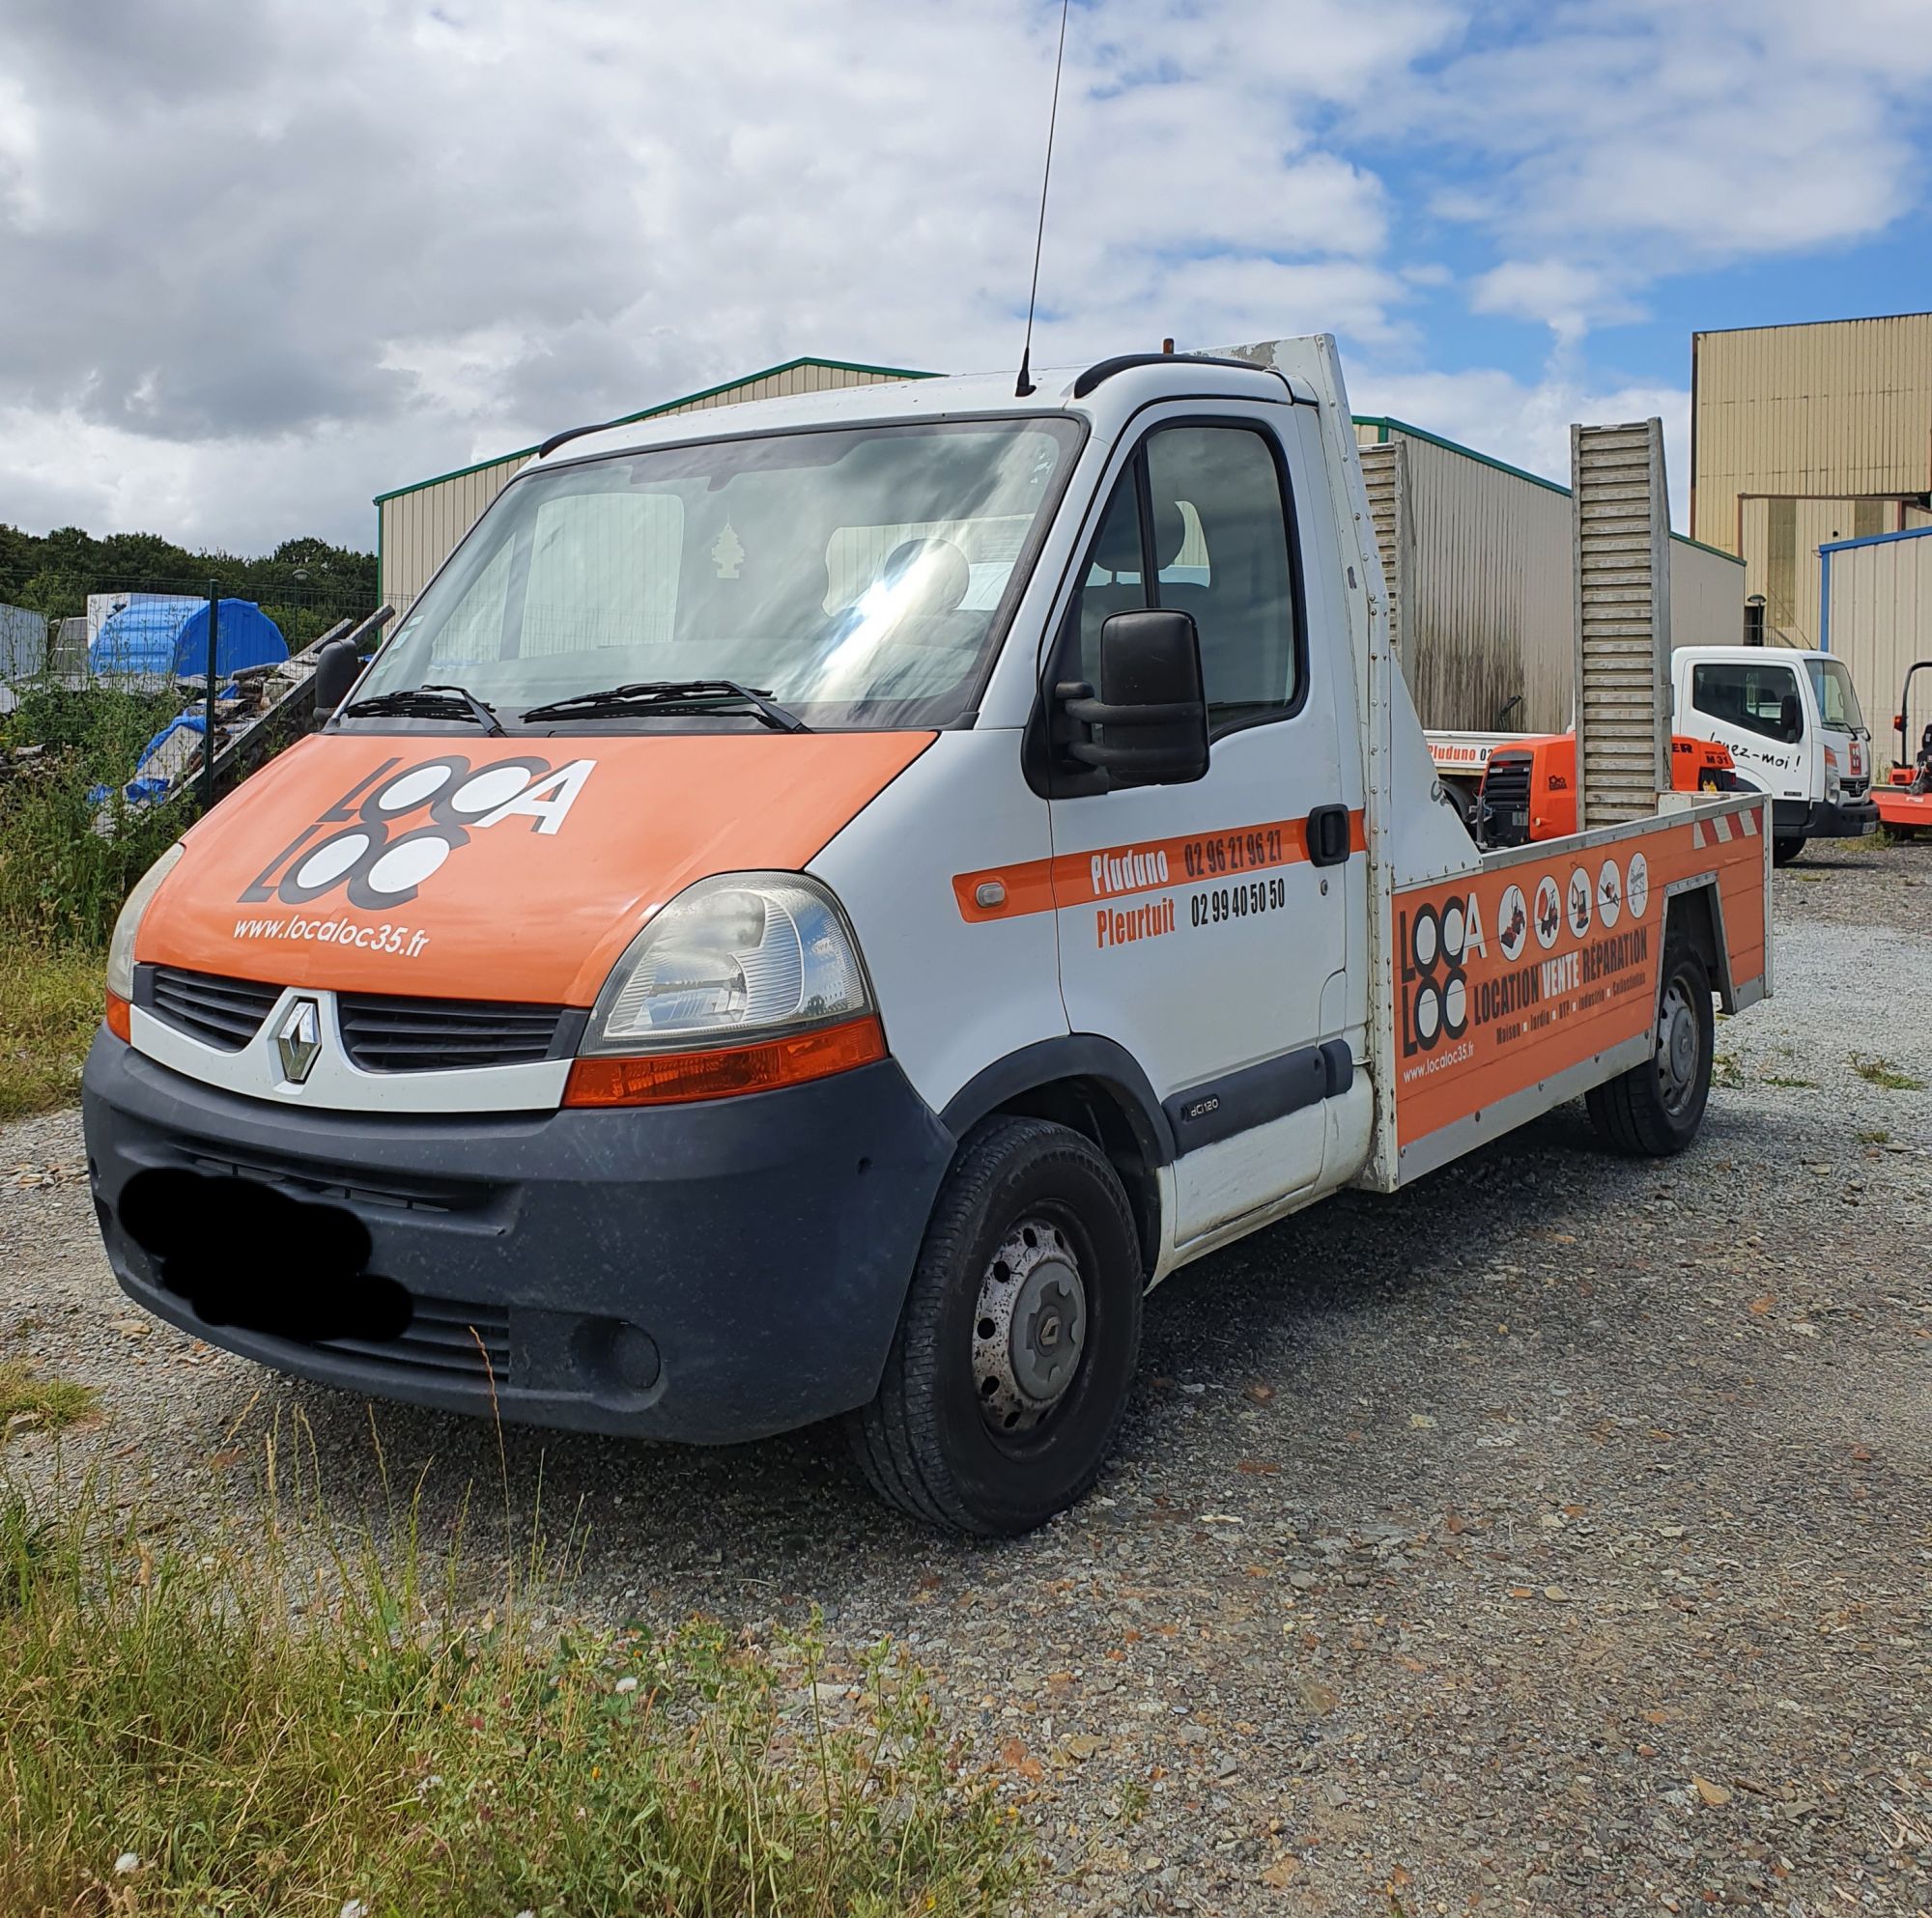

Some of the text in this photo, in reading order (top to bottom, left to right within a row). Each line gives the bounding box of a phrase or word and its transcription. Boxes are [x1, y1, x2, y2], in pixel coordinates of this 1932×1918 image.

[316, 755, 598, 834] LOCA
[1090, 850, 1169, 895] Pluduno
[1184, 843, 1205, 877] 02
[1206, 840, 1225, 873] 96
[1246, 832, 1265, 865] 96
[233, 915, 431, 958] www.localoc35.fr
[1096, 878, 1286, 948] Pleurtuit 02 99 40 50 50
[1400, 892, 1488, 984] LOCA
[1402, 968, 1469, 1058] LOC
[1473, 964, 1539, 1027] LOCATION
[1542, 951, 1580, 1000] VENTE
[1404, 1040, 1475, 1084] www.localoc35.fr
